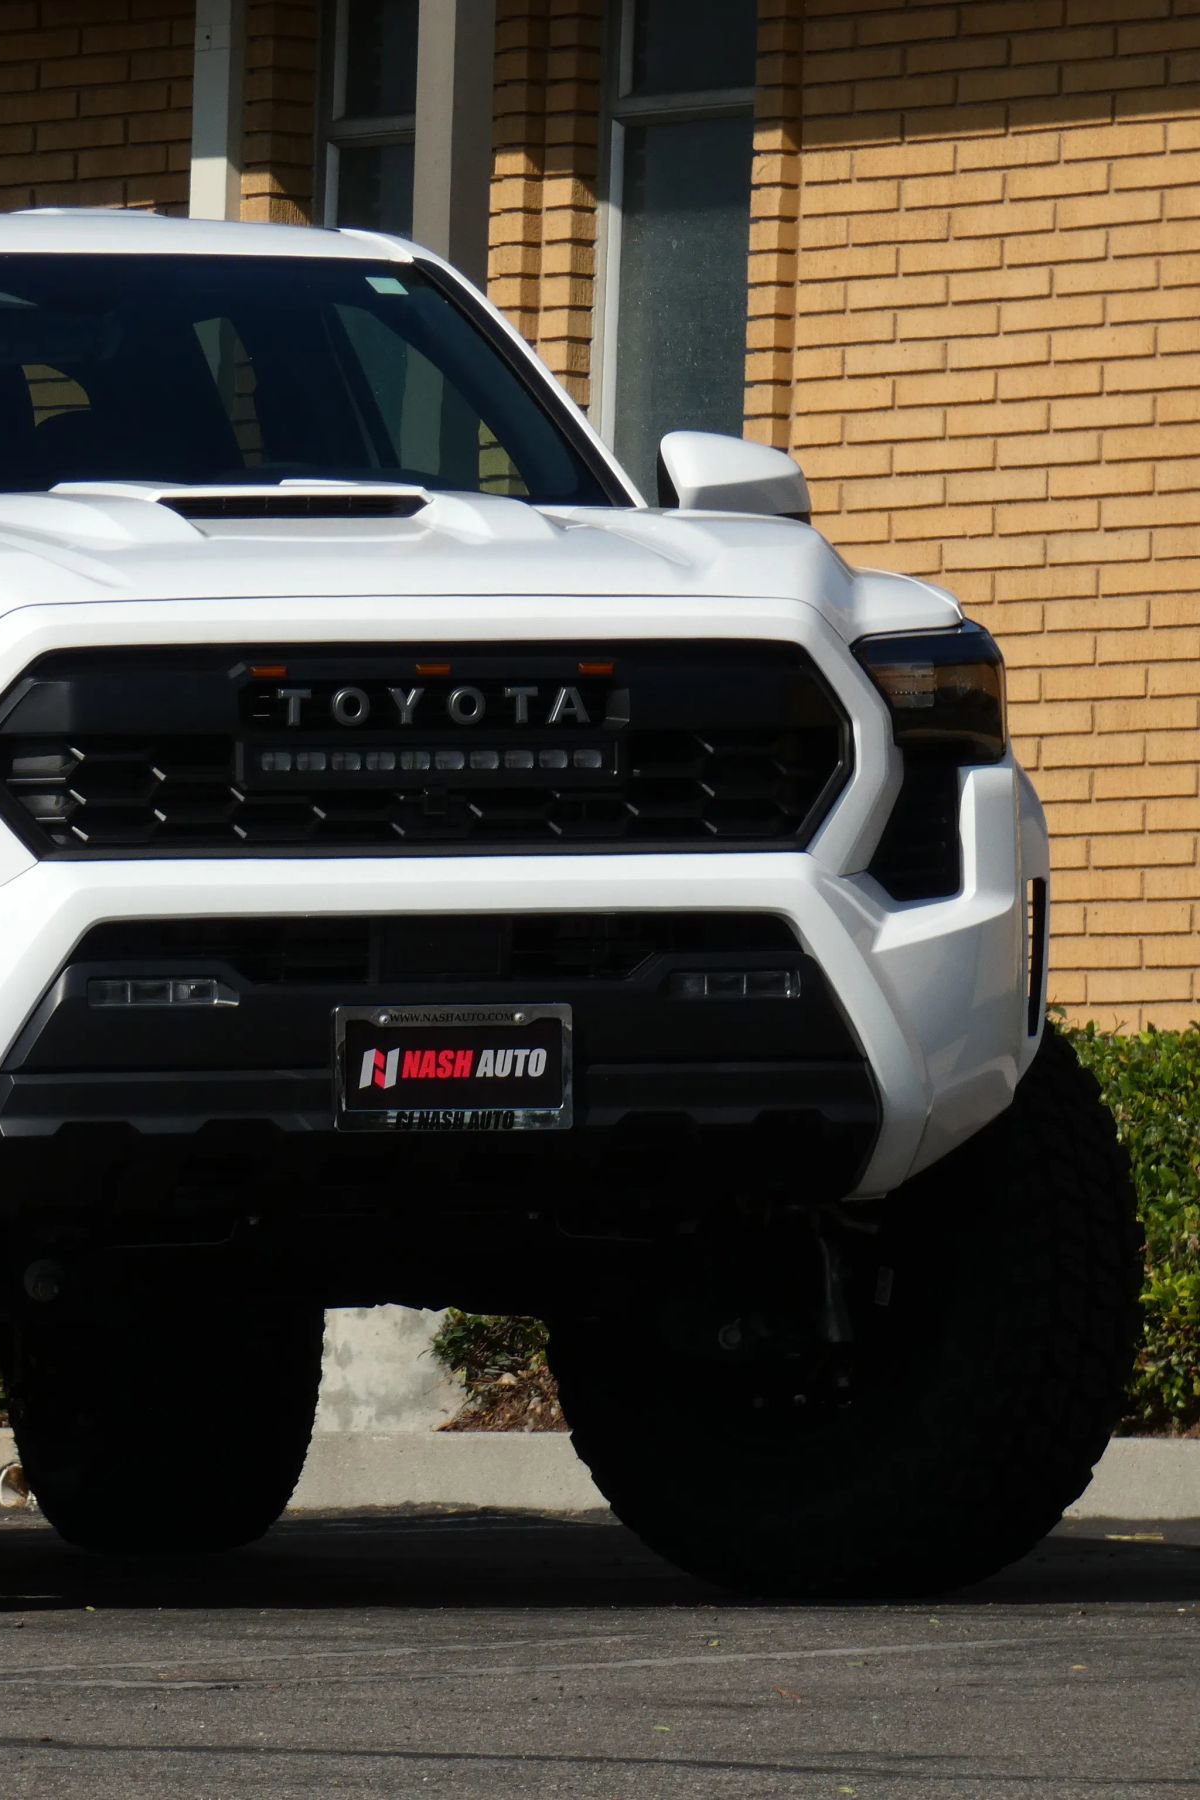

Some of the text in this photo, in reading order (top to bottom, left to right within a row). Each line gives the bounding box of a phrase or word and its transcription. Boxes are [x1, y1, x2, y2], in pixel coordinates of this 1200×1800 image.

[277, 686, 590, 727] TOYOTA
[389, 1011, 515, 1024] WWW.NASHAUTO.COM
[402, 1050, 475, 1079] NASH
[475, 1048, 548, 1078] AUTO
[416, 1110, 465, 1129] NASH
[467, 1110, 515, 1129] AUTO
